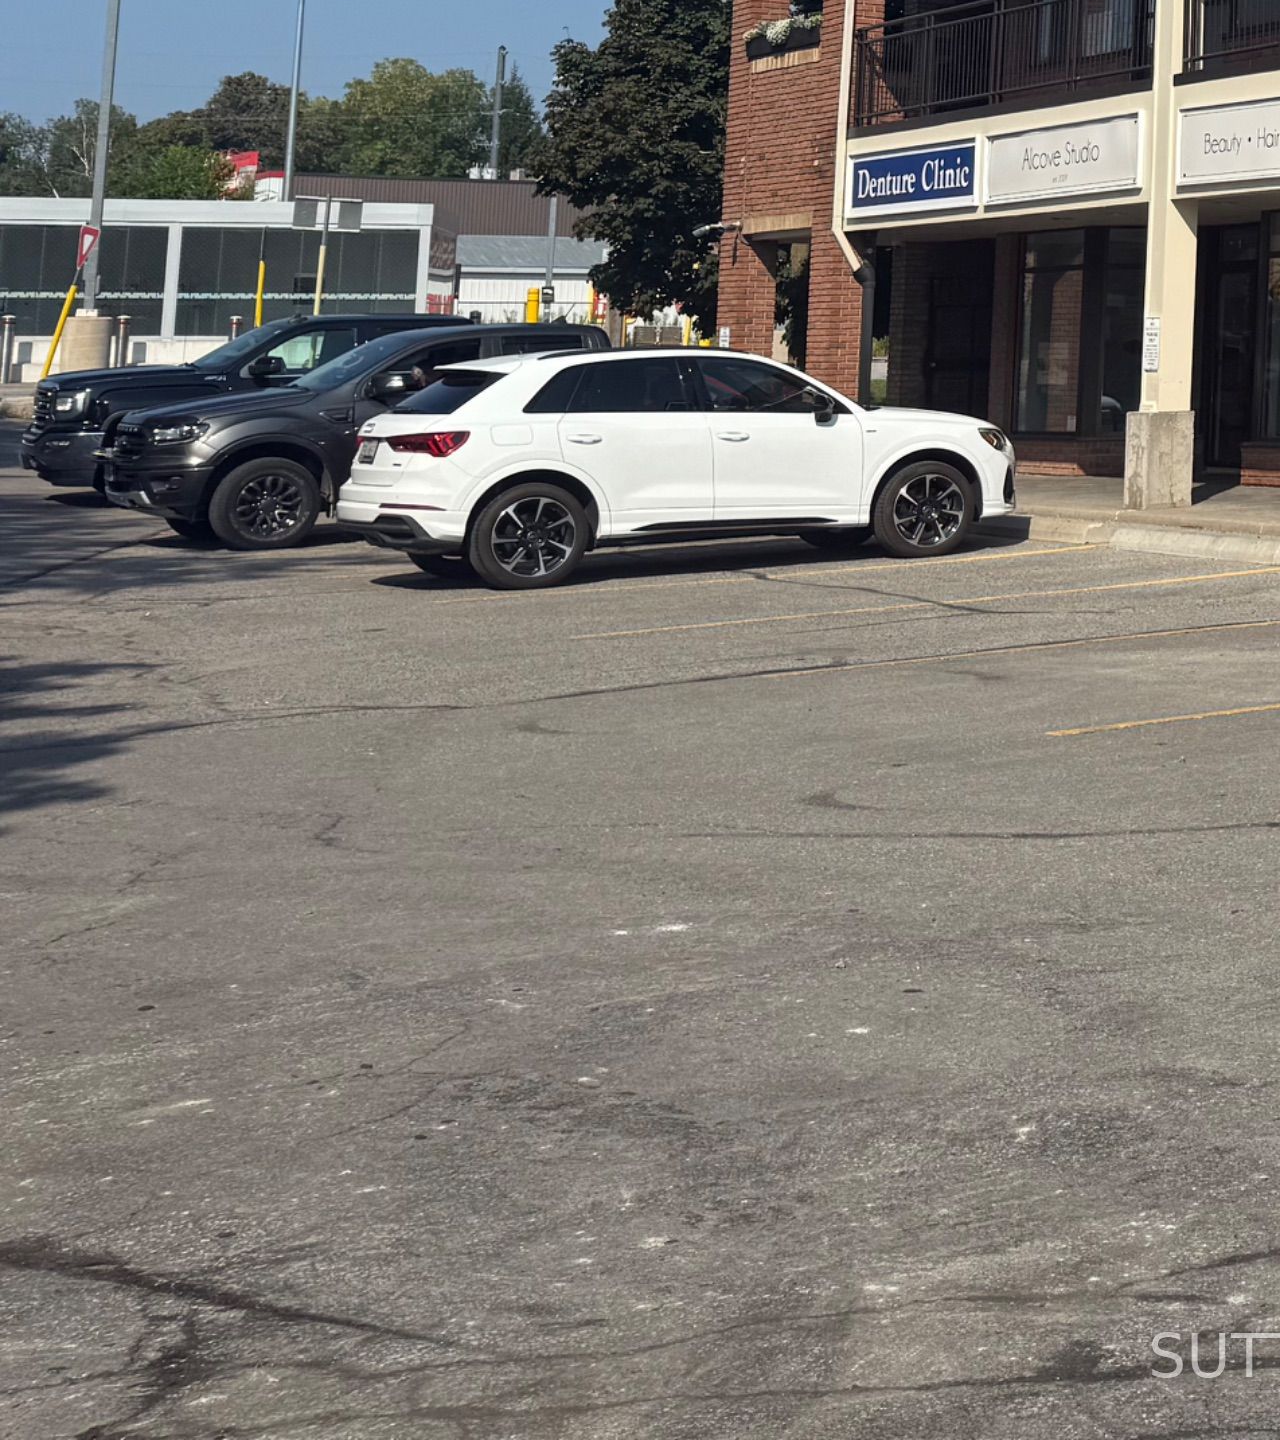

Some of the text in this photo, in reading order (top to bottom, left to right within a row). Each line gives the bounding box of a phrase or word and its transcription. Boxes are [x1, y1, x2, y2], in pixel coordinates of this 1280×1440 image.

[1021, 139, 1100, 171] Alcove Studio
[1204, 132, 1242, 155] Beauty
[1257, 126, 1280, 148] Hair
[857, 157, 970, 199] Denture Clinic
